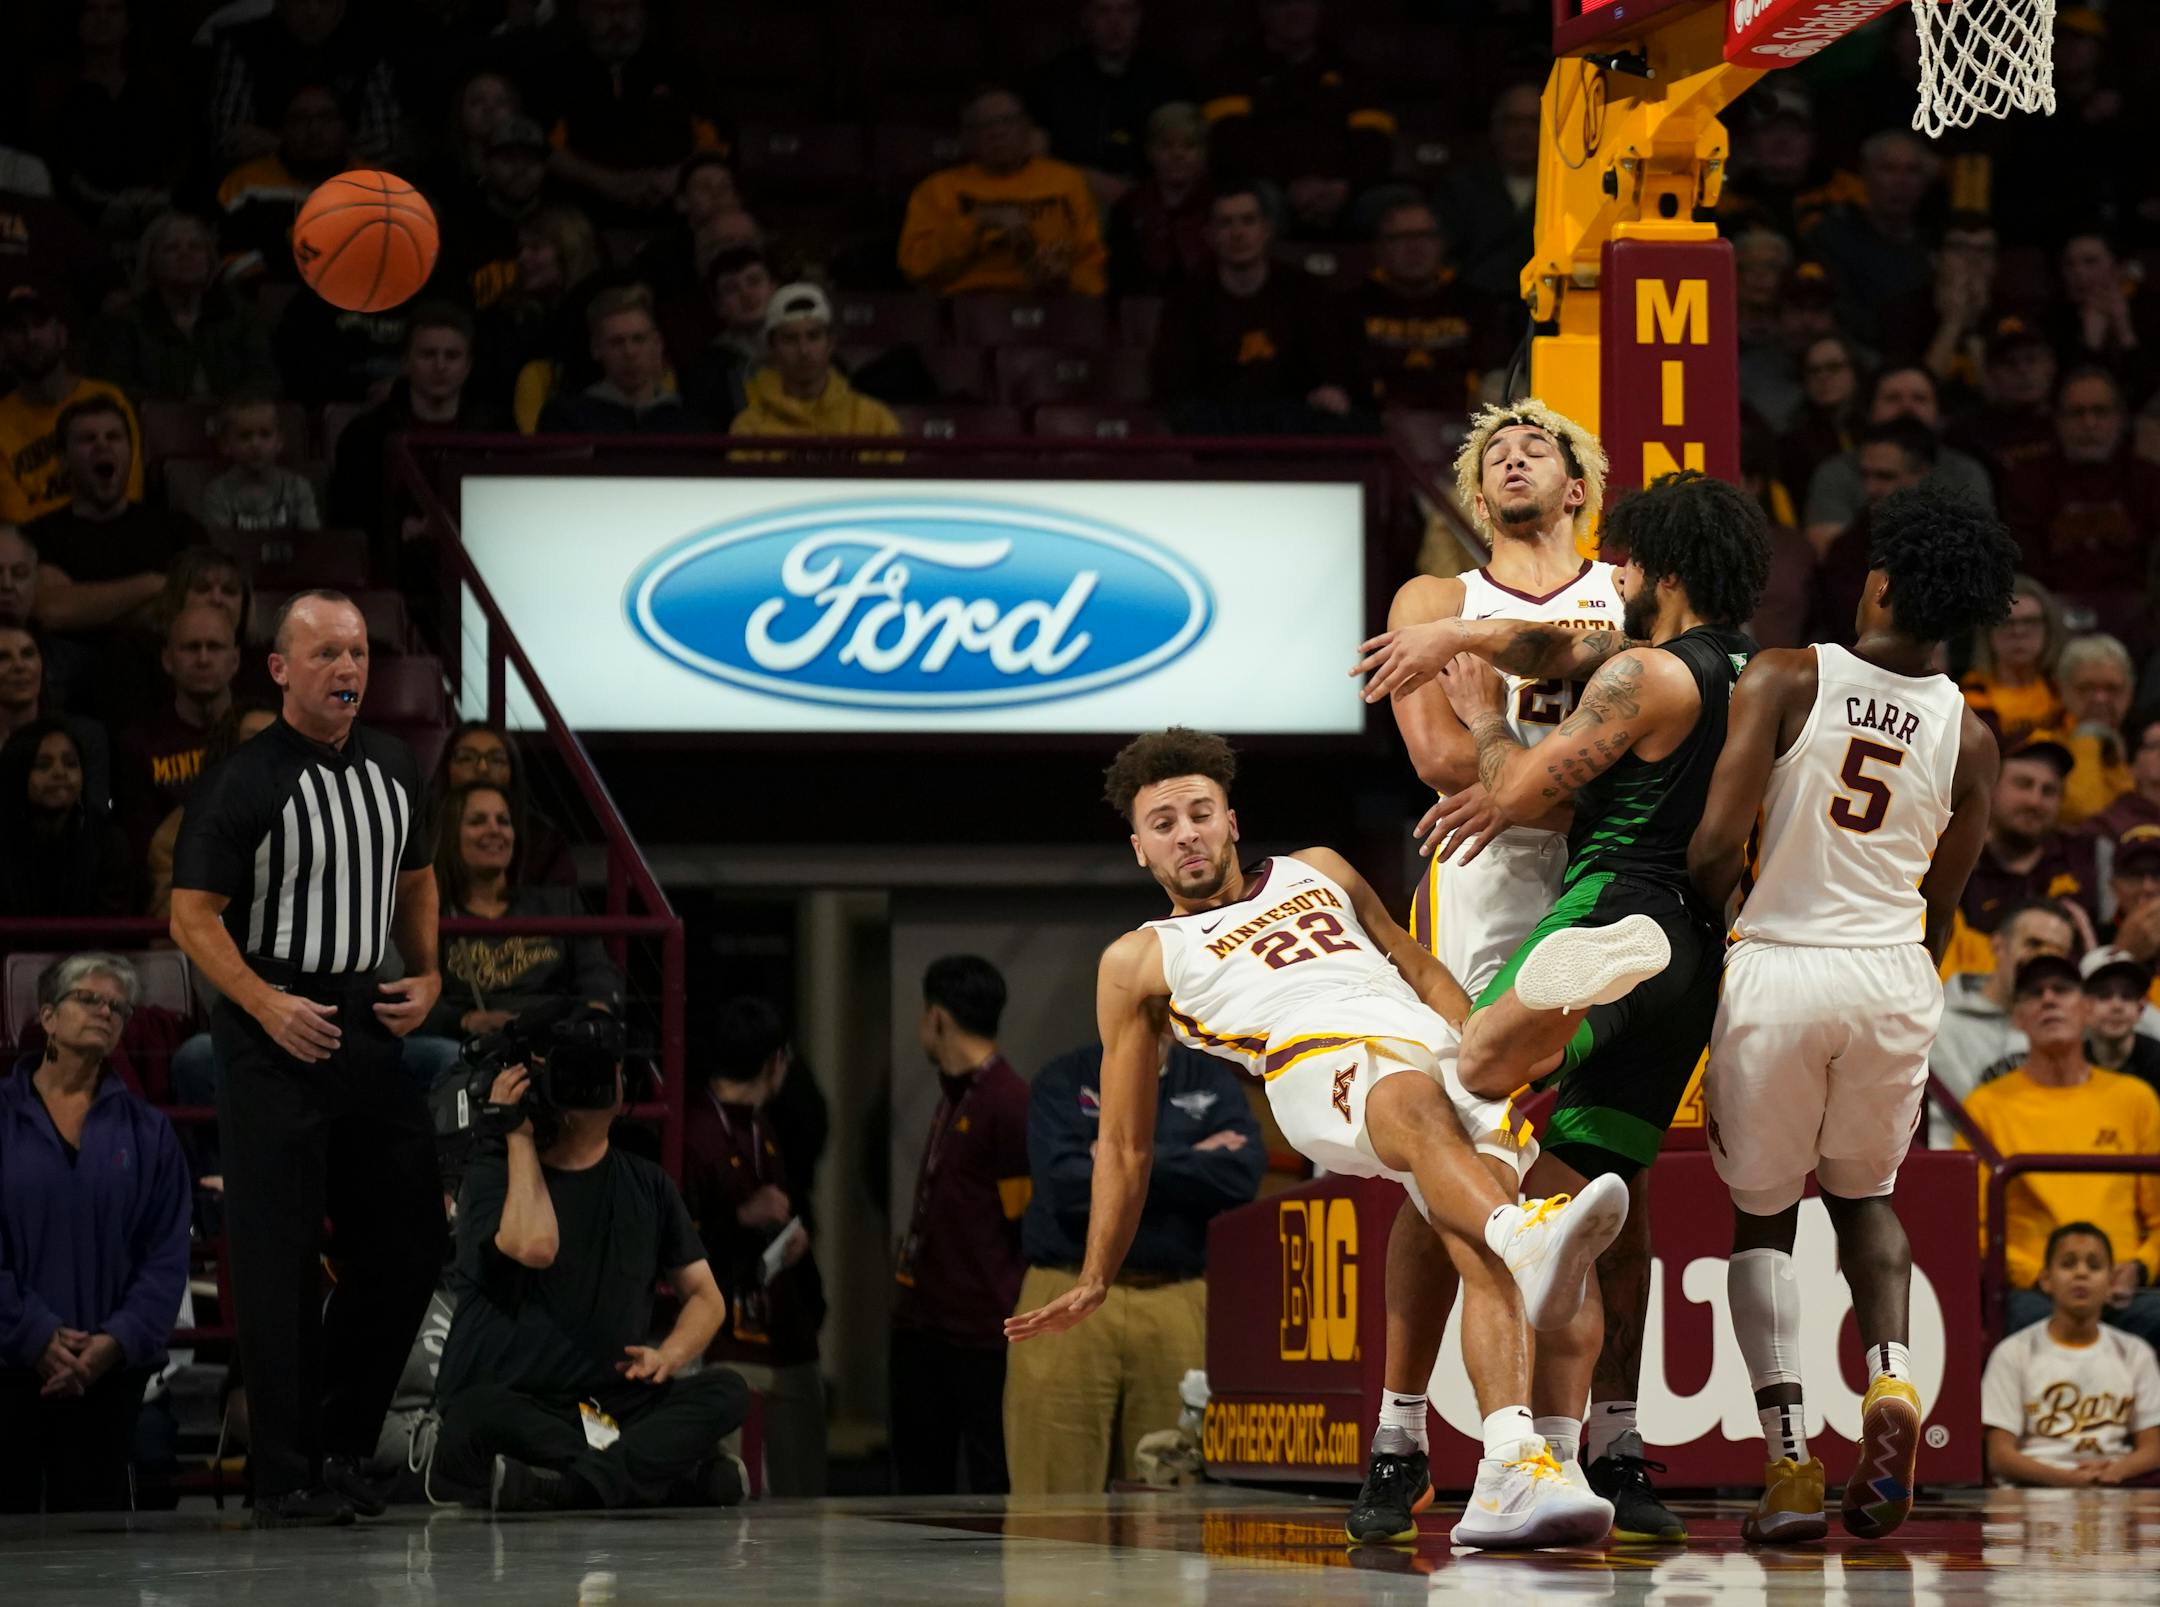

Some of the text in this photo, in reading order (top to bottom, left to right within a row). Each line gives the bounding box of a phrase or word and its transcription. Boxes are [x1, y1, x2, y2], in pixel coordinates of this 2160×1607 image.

[744, 528, 1100, 677] Ford
[1846, 697, 1920, 744] CARR
[1828, 736, 1904, 835] 5
[1205, 888, 1344, 960] MINNESOTA
[1250, 911, 1362, 970] 22
[1202, 1402, 1361, 1464] GOPHERSPORTS.com
